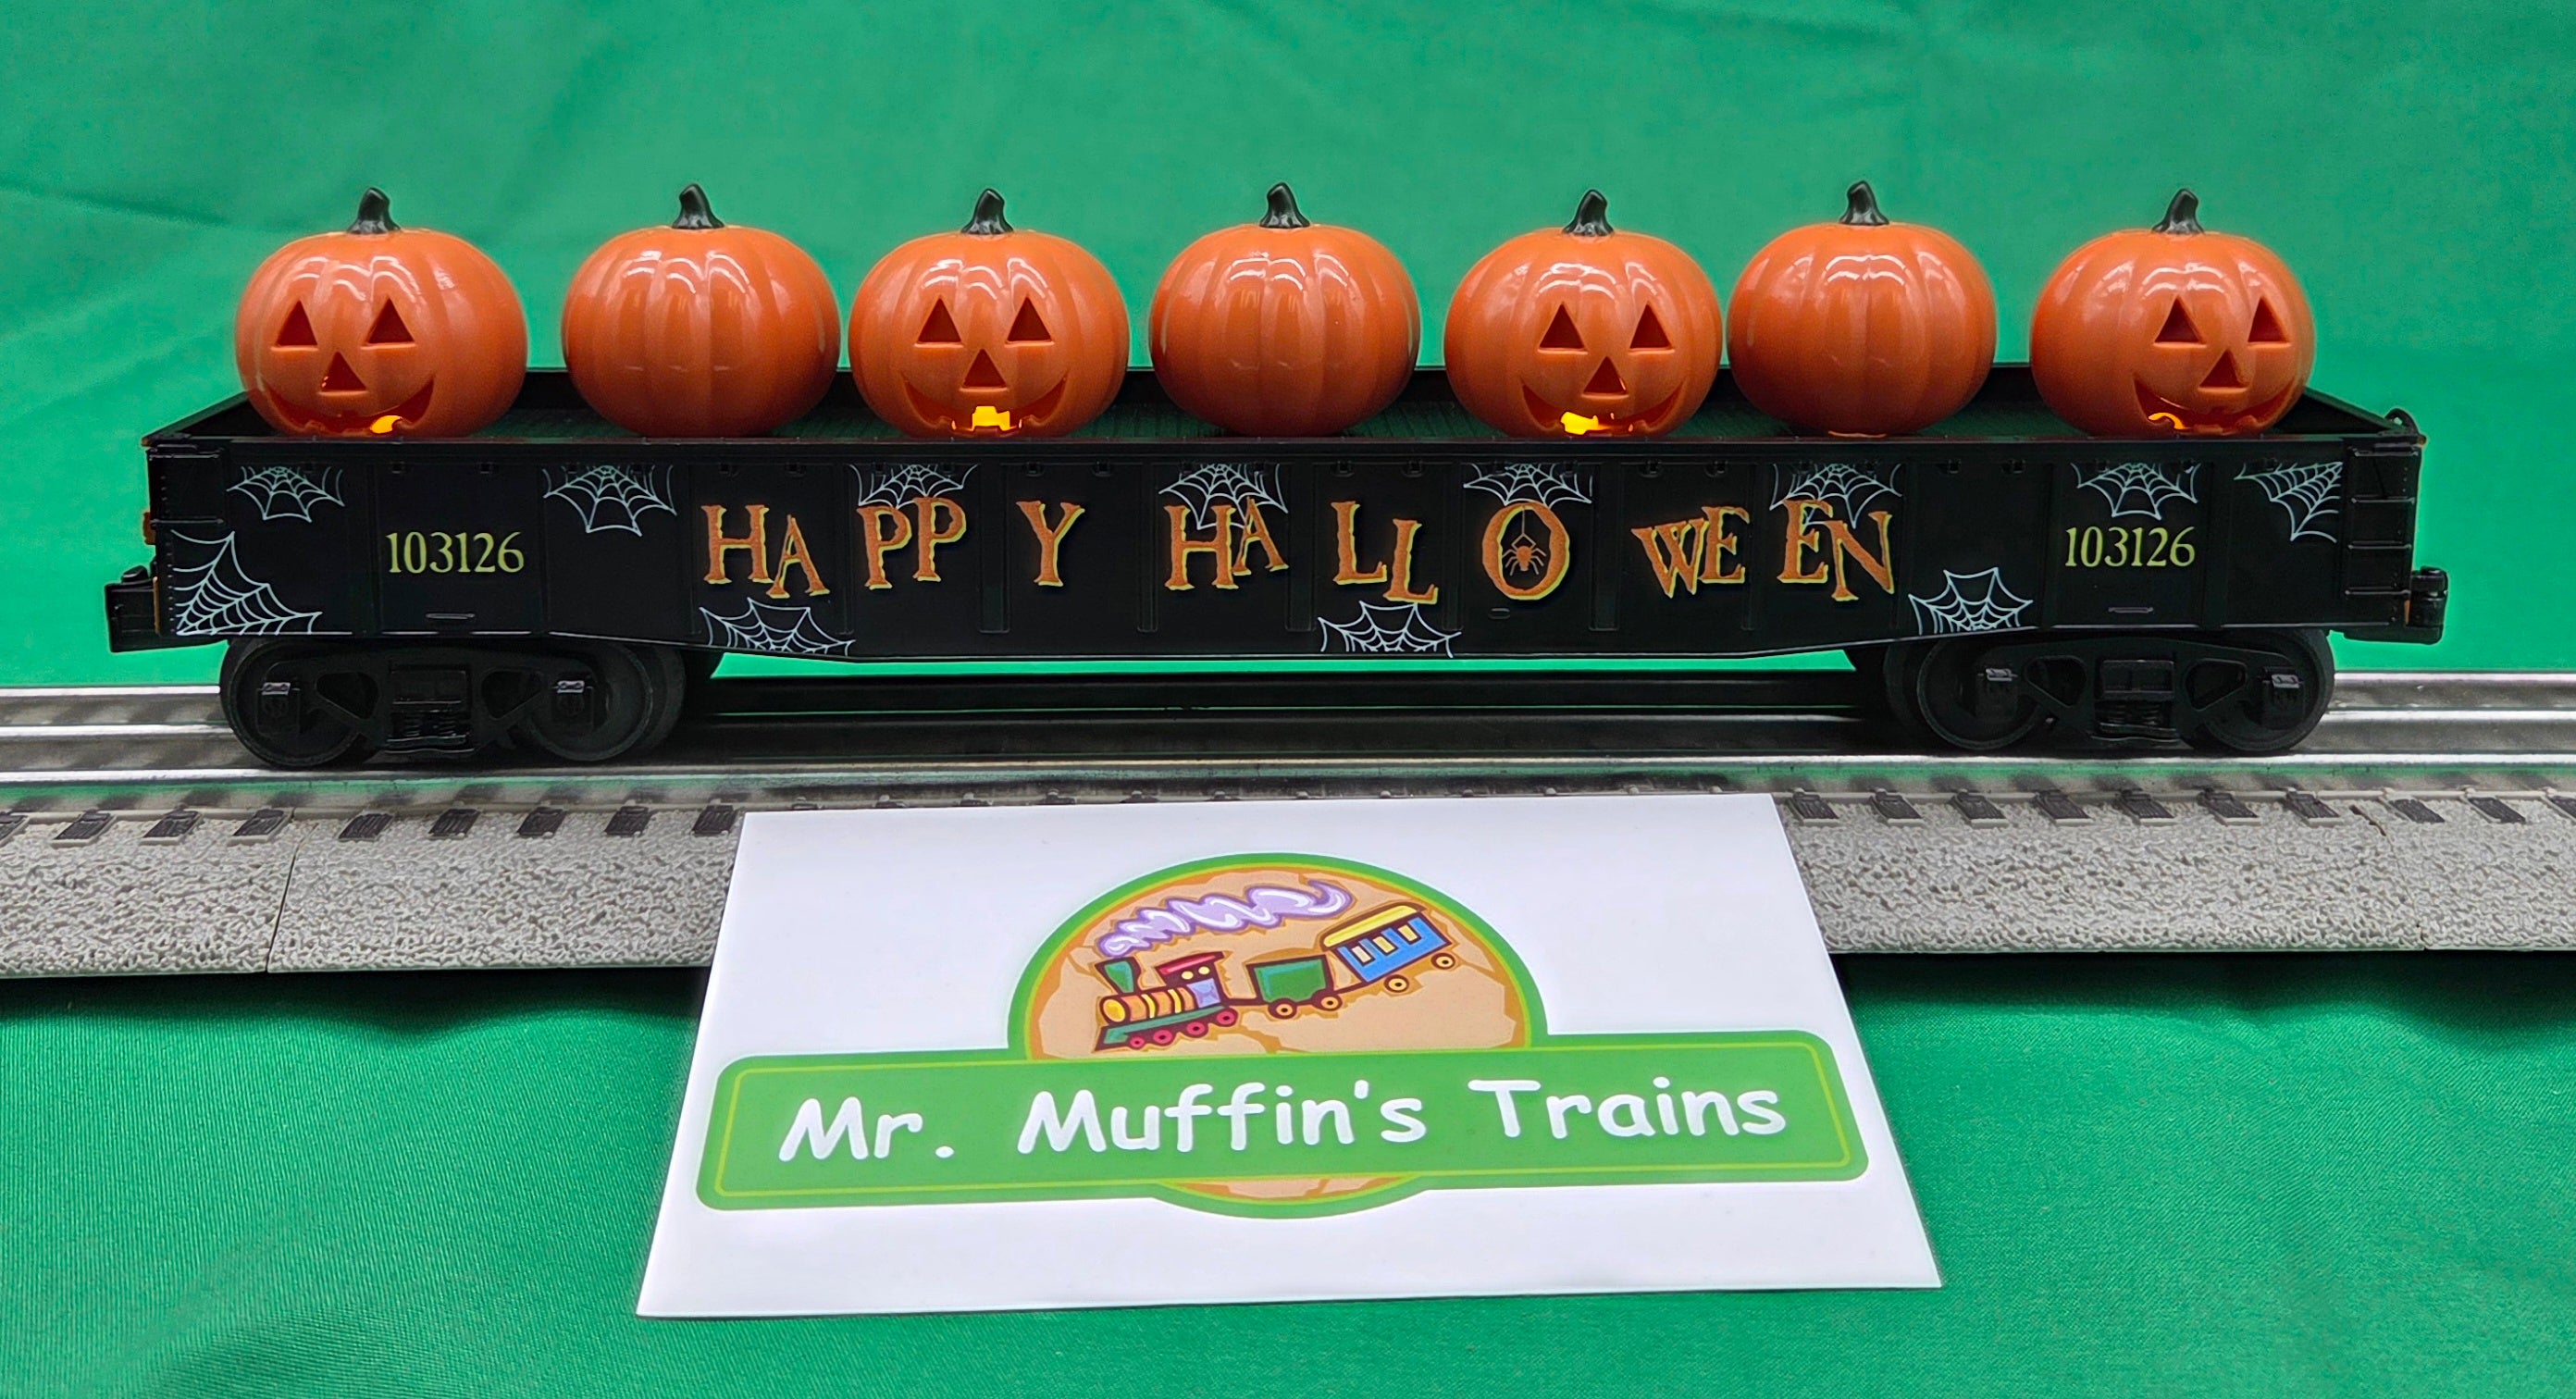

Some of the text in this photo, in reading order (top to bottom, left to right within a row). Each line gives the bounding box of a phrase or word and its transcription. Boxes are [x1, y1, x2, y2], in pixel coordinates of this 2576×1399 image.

[385, 530, 526, 575] 103126
[701, 497, 1085, 599] HAPPY
[2063, 526, 2197, 568] 103126
[778, 1076, 1788, 1163] Mr. Muffin's Trains
